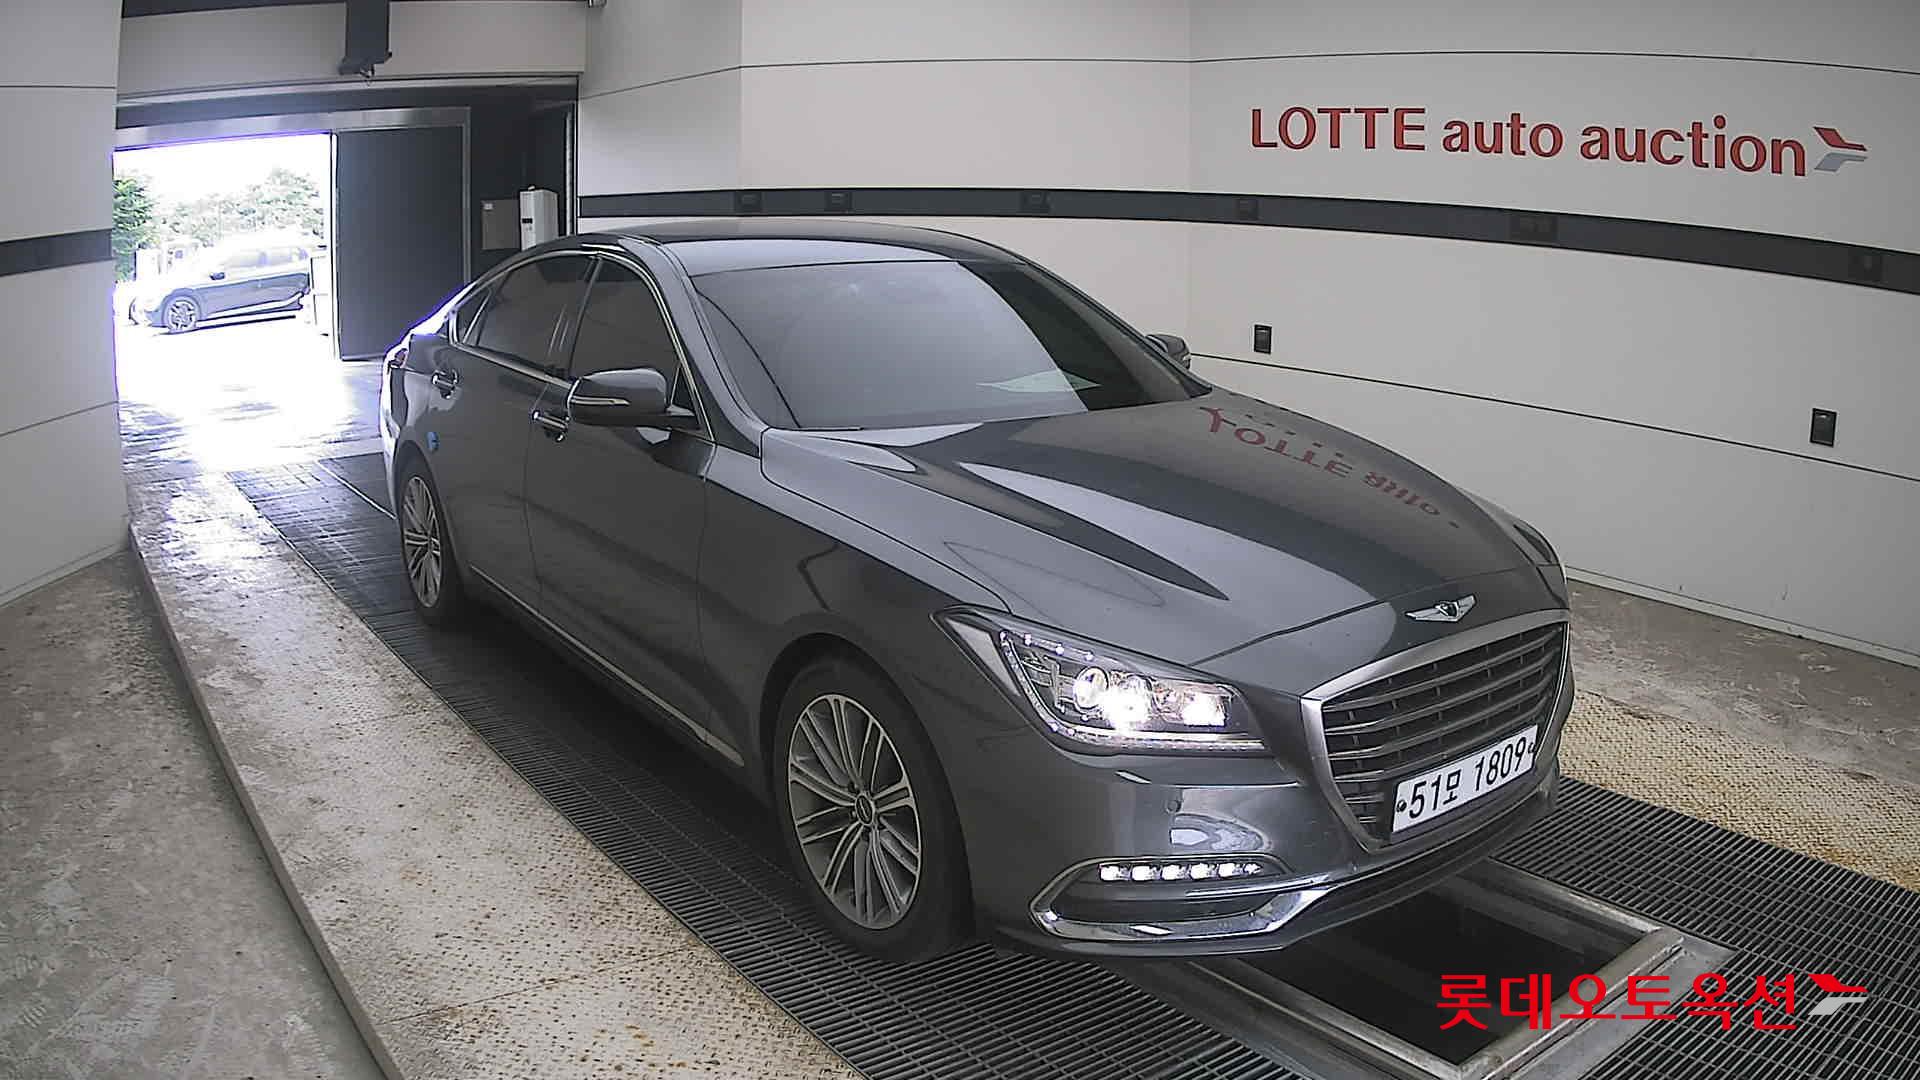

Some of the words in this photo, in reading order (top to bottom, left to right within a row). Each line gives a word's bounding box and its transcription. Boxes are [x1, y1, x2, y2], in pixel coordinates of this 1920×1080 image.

[1251, 106, 1426, 151] LOTTE
[1442, 112, 1564, 158] auto
[1579, 115, 1807, 177] auction
[1408, 768, 1462, 819] 51모
[1475, 736, 1528, 792] 1809
